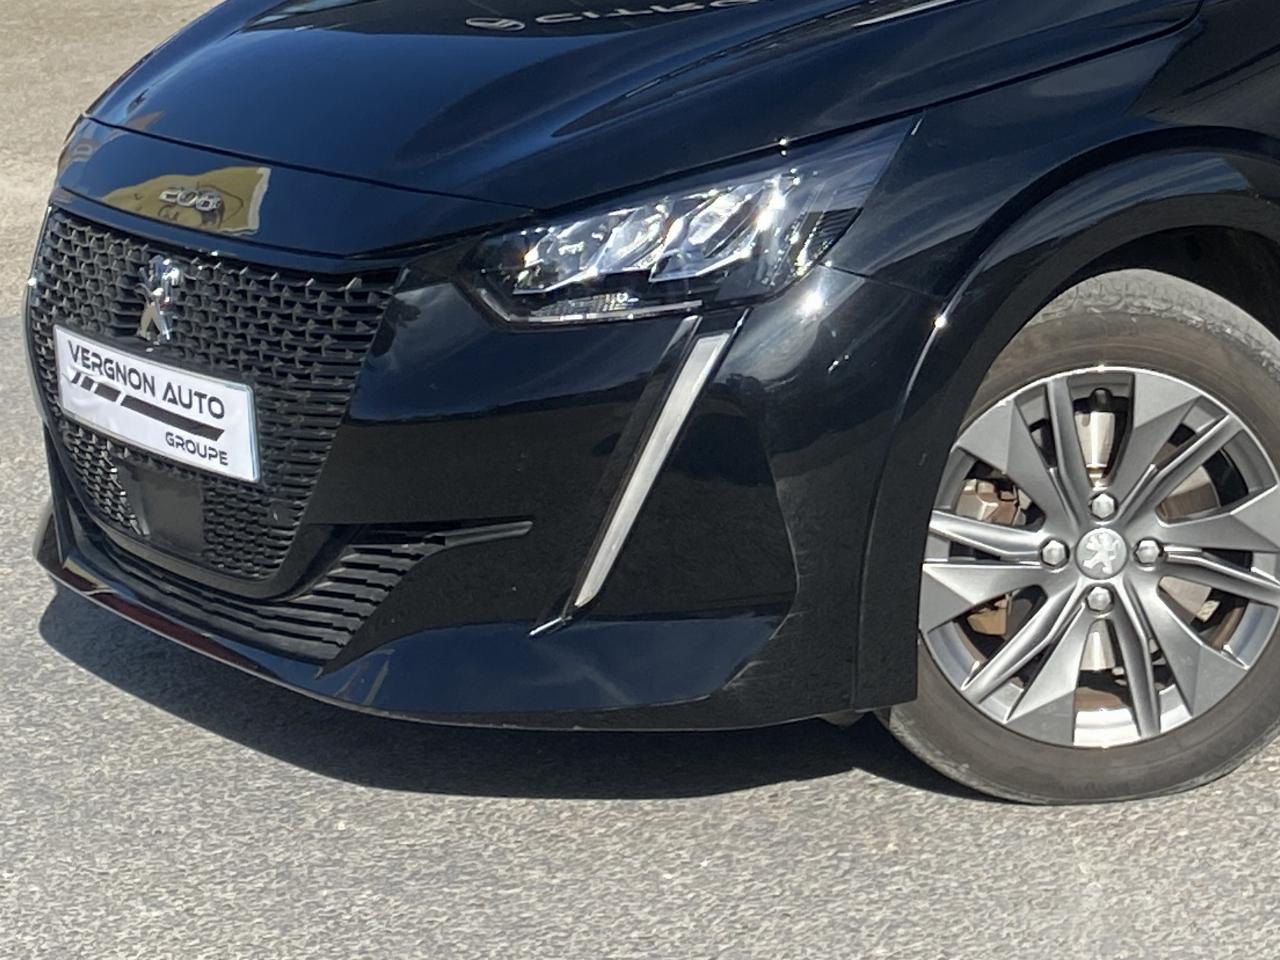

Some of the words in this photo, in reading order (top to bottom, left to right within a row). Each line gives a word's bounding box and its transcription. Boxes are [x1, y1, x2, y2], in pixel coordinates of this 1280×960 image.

[68, 340, 156, 397] VERGNON
[162, 381, 225, 420] AUTO
[165, 431, 228, 466] GROUPE
